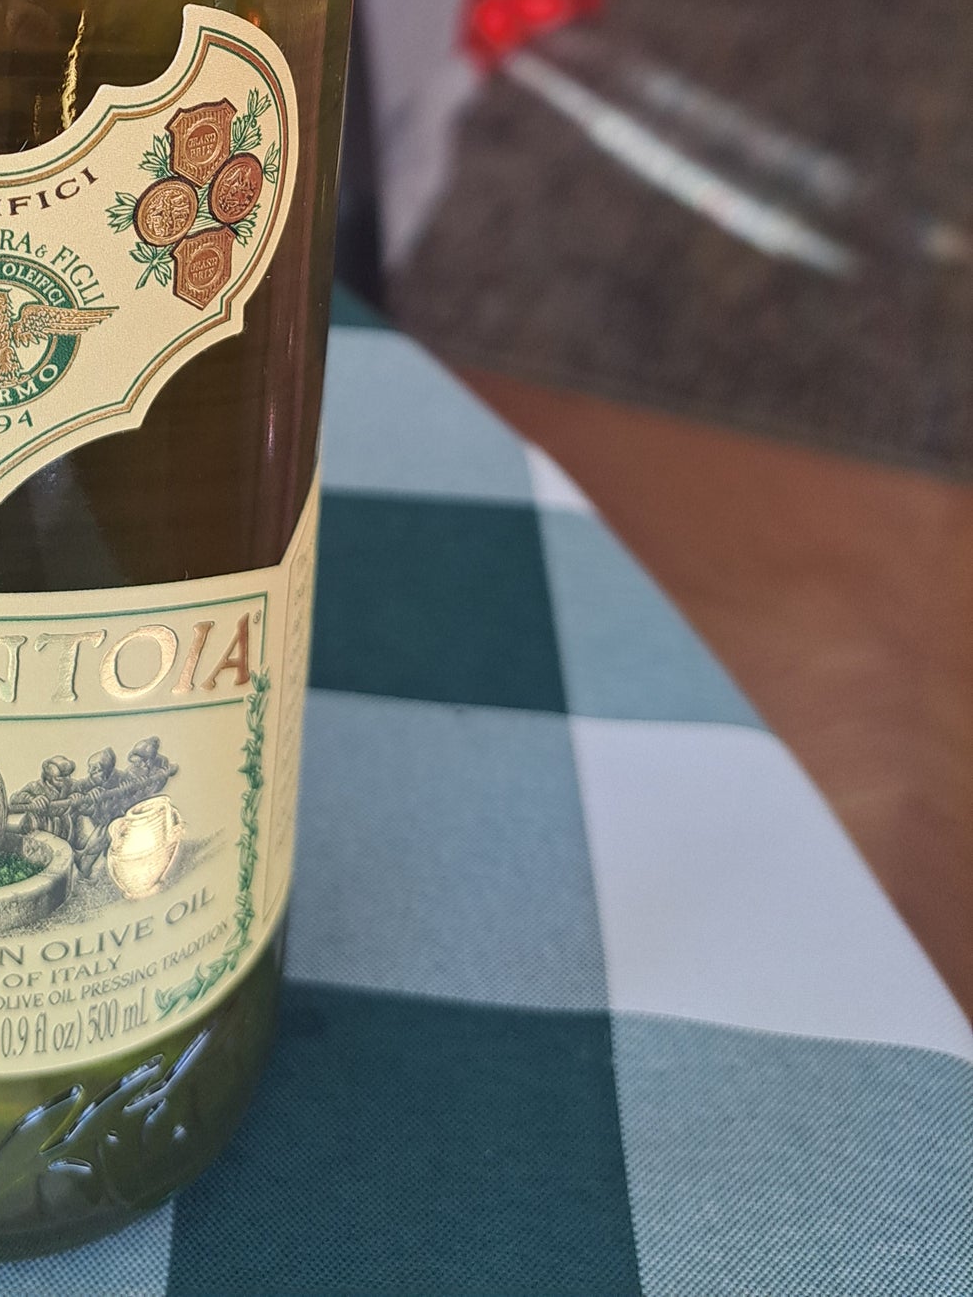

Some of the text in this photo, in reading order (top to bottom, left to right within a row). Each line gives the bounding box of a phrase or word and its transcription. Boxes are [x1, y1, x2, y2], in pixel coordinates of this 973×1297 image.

[2, 262, 66, 306] OLEIFICI
[34, 244, 47, 259] &
[50, 244, 105, 306] FIGLI
[40, 916, 154, 962] OLIVE
[165, 886, 215, 926] OIL
[3, 971, 42, 988] OF
[51, 954, 123, 984] ITALY
[48, 991, 76, 1005] OIL
[80, 962, 157, 1000] PRESSING
[161, 920, 228, 970] TRADITION
[1, 1016, 29, 1058] 0.9
[35, 1012, 47, 1053] fl
[53, 1010, 82, 1051] oz)
[87, 998, 118, 1044] 500
[122, 986, 148, 1033] mL
